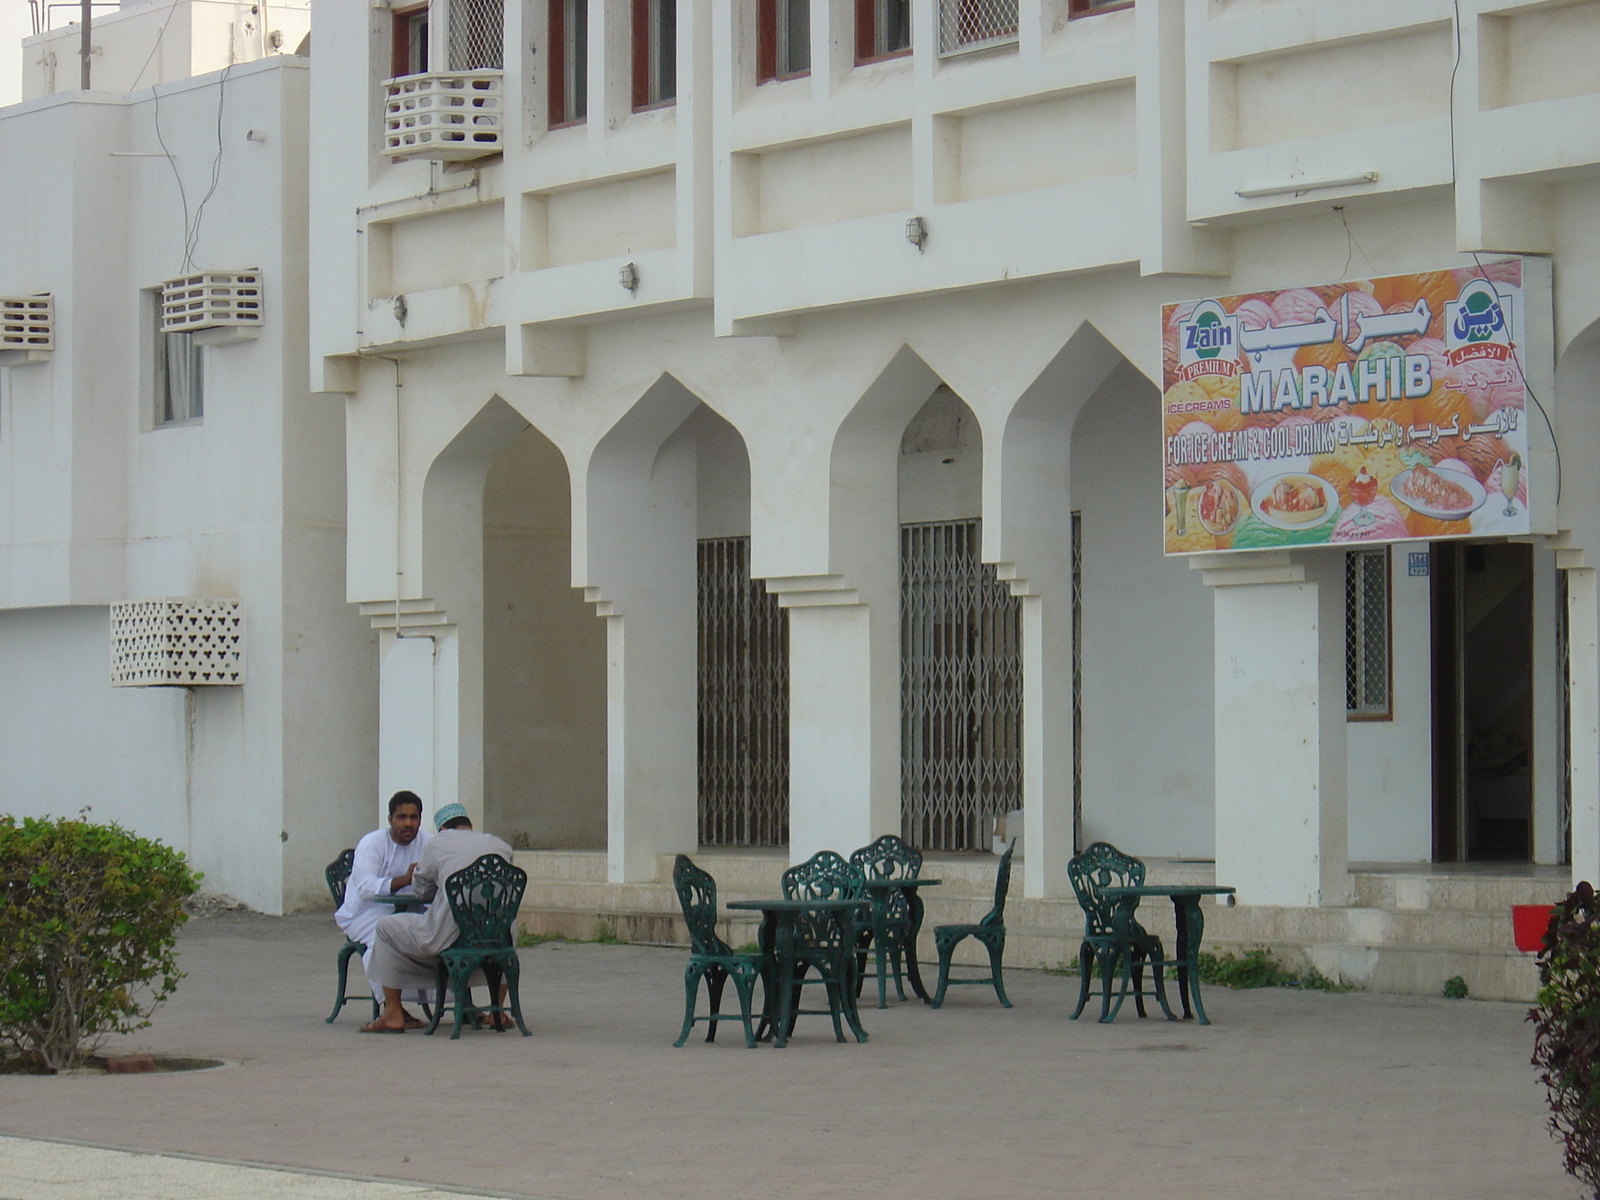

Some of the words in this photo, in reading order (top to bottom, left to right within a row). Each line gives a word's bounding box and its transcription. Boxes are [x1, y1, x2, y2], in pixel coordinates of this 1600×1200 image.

[1185, 323, 1232, 349] Zain
[1239, 292, 1432, 363] مراحب
[1453, 302, 1504, 340] زين
[1187, 361, 1231, 379] PREMIUM
[1240, 354, 1433, 415] MARAHIB
[1167, 403, 1184, 414] ICE
[1185, 399, 1231, 413] CREAMS
[1167, 434, 1190, 466] FOR
[1190, 432, 1209, 464] ICE
[1211, 428, 1250, 463] CREAM
[1251, 427, 1261, 461] &
[1262, 424, 1293, 460] COOL
[1295, 421, 1336, 456] DRINKS
